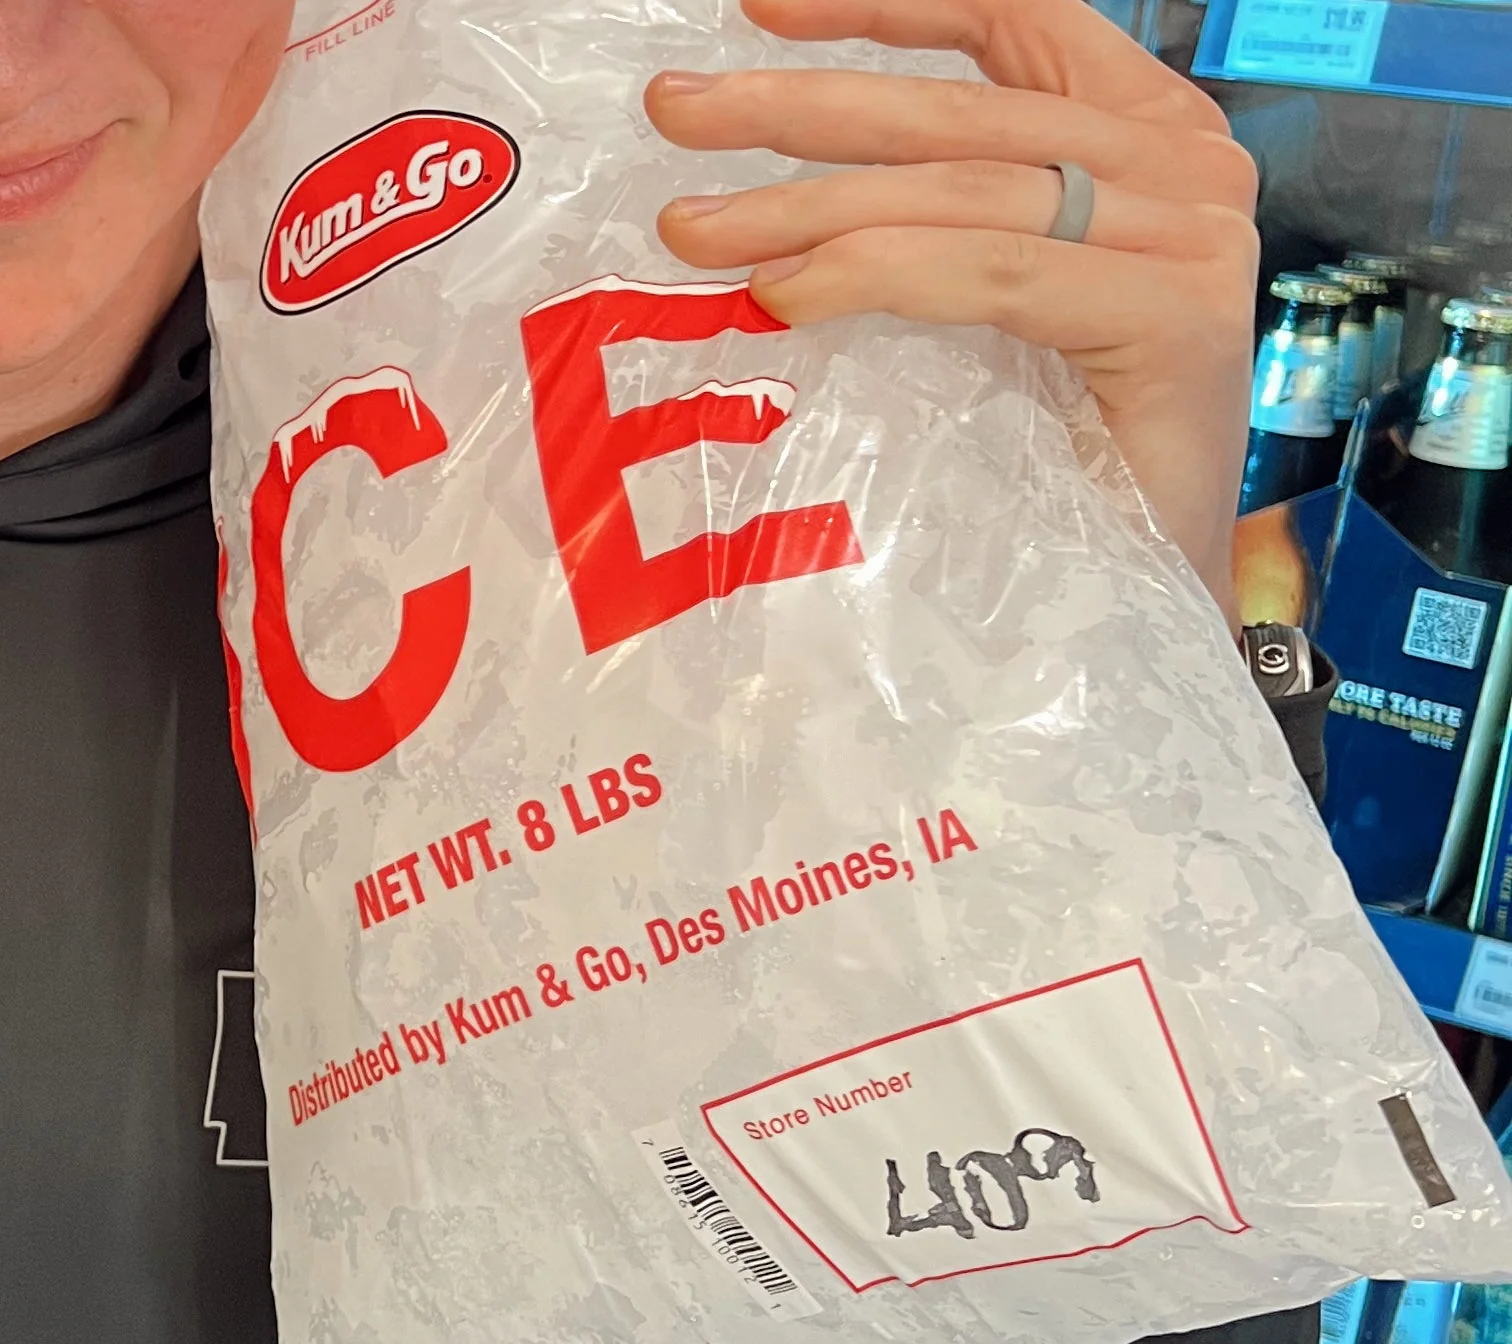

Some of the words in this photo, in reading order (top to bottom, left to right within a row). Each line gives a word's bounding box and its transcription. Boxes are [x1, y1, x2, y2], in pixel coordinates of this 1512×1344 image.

[303, 32, 347, 62] FILL
[278, 191, 364, 284] Kum
[370, 169, 402, 215] &
[405, 139, 484, 209] Go
[223, 273, 864, 781] CE
[1333, 679, 1387, 710] ORE
[1388, 690, 1463, 729] TASTE
[354, 852, 427, 931] NET
[427, 817, 513, 892] WT.
[517, 798, 556, 852] 8
[561, 752, 665, 835] LBS
[287, 1030, 401, 1128] Distributed
[401, 1017, 446, 1068] by
[445, 982, 533, 1044] Kum
[535, 962, 576, 1009] &
[575, 939, 648, 993] Go,
[644, 906, 727, 966] Des
[725, 839, 917, 933] Moines,
[916, 807, 980, 866] IA
[743, 1105, 811, 1142] Store
[813, 1069, 914, 1118] Number
[885, 1127, 1101, 1240] 409
